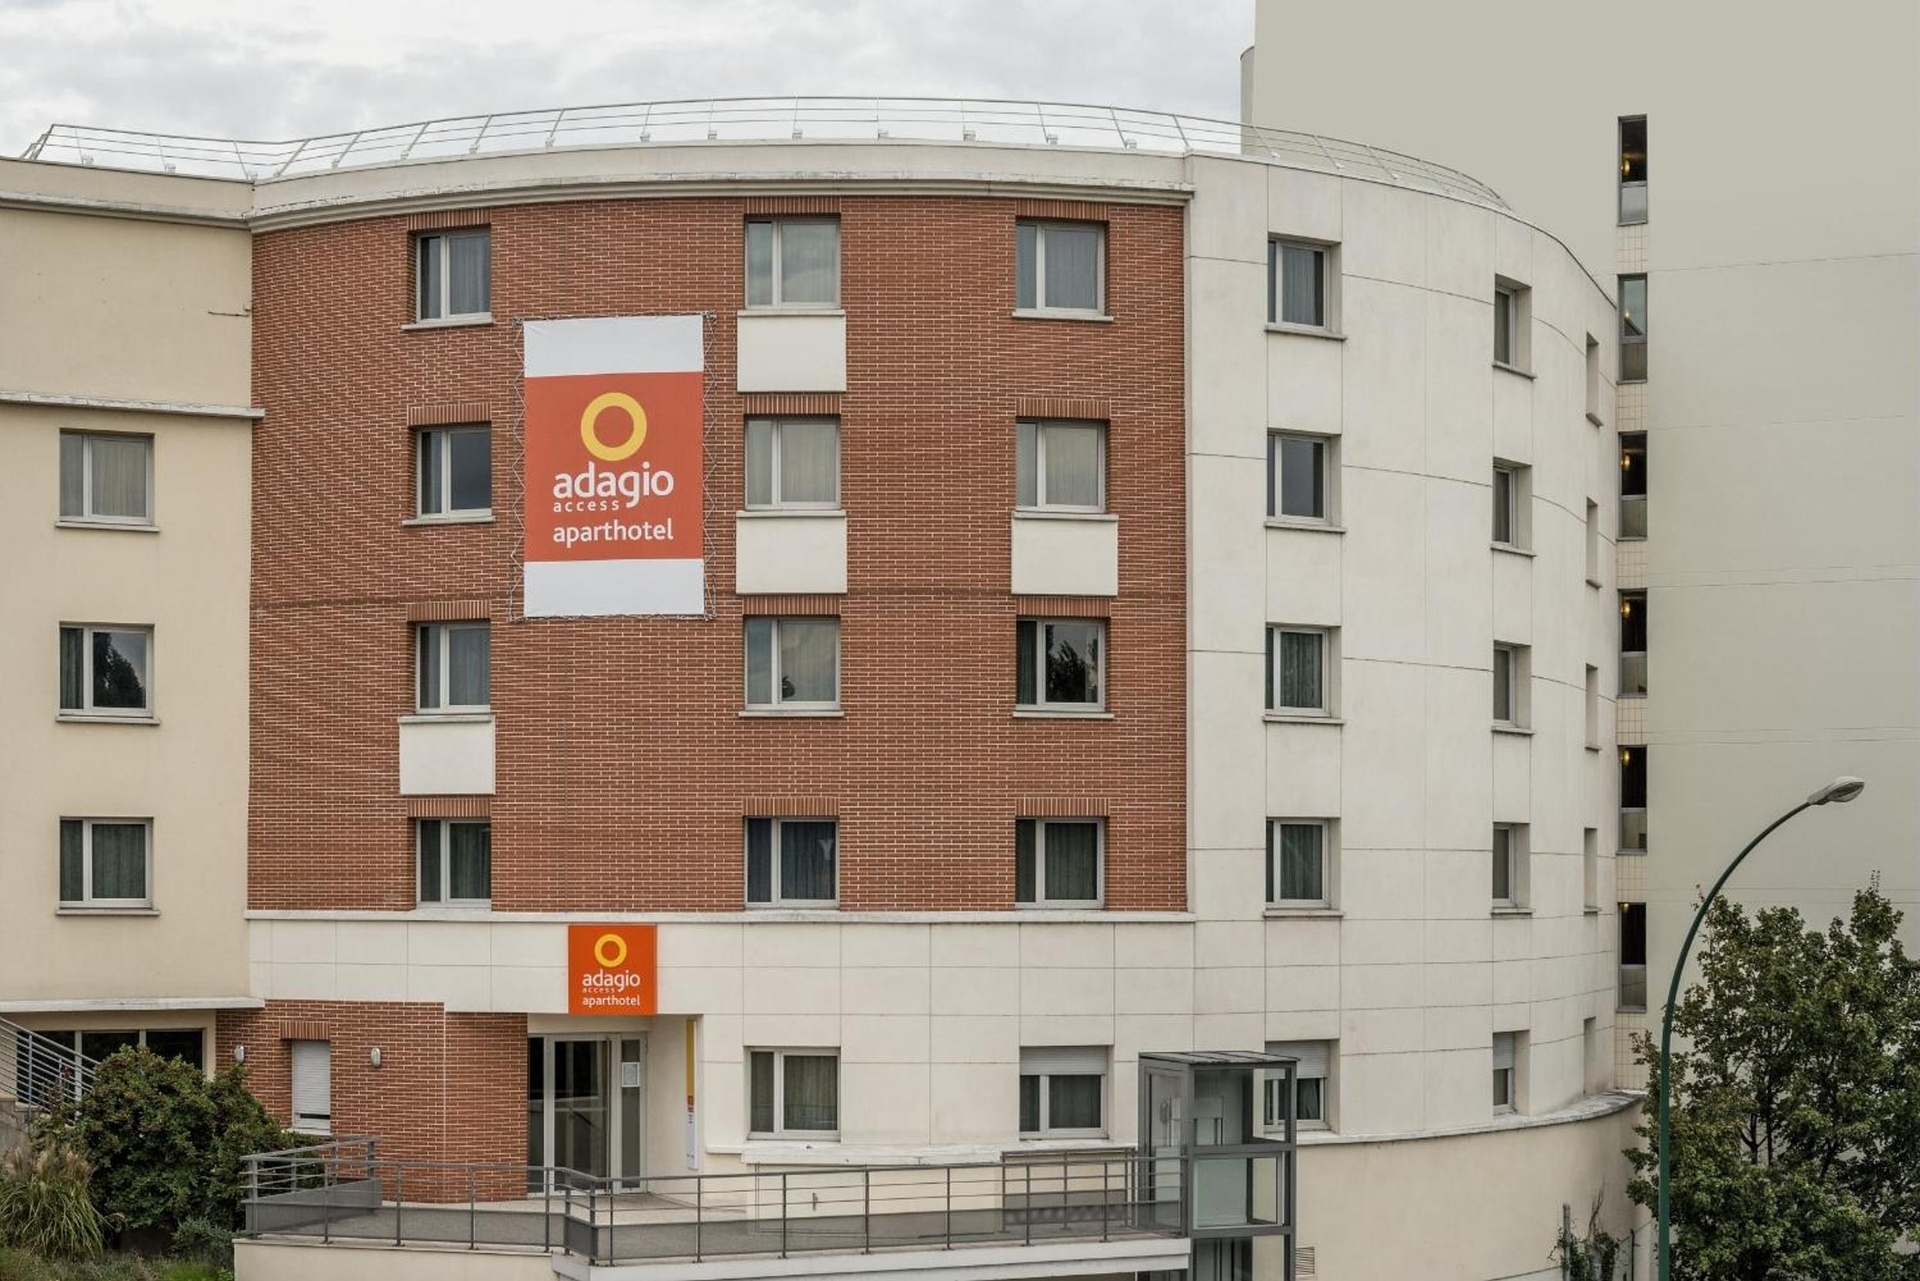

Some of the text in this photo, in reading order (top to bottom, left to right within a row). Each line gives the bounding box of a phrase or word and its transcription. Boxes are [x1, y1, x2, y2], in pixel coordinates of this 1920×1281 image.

[553, 461, 674, 507] adagio
[553, 500, 619, 512] access
[553, 518, 674, 548] aparthotel
[582, 968, 641, 992] adagio
[582, 994, 640, 1008] aparthotel
